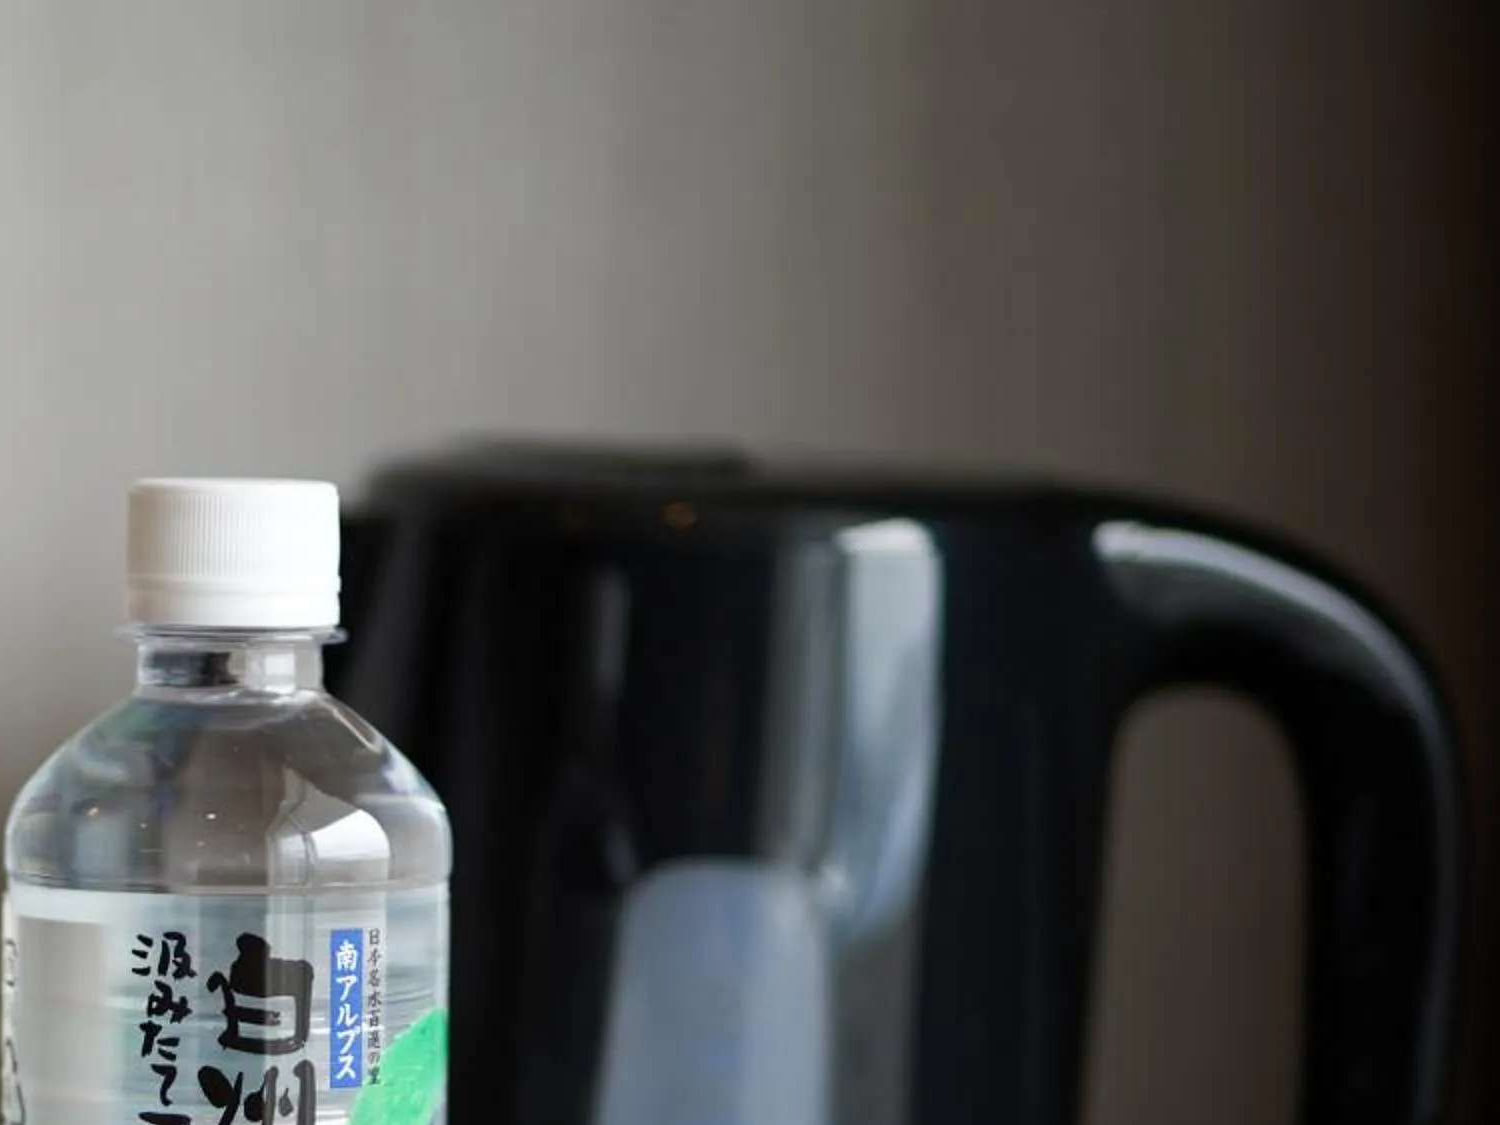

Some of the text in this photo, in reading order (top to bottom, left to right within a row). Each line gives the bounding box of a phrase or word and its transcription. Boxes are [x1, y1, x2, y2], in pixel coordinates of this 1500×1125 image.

[335, 939, 360, 1080] 南アルプス
